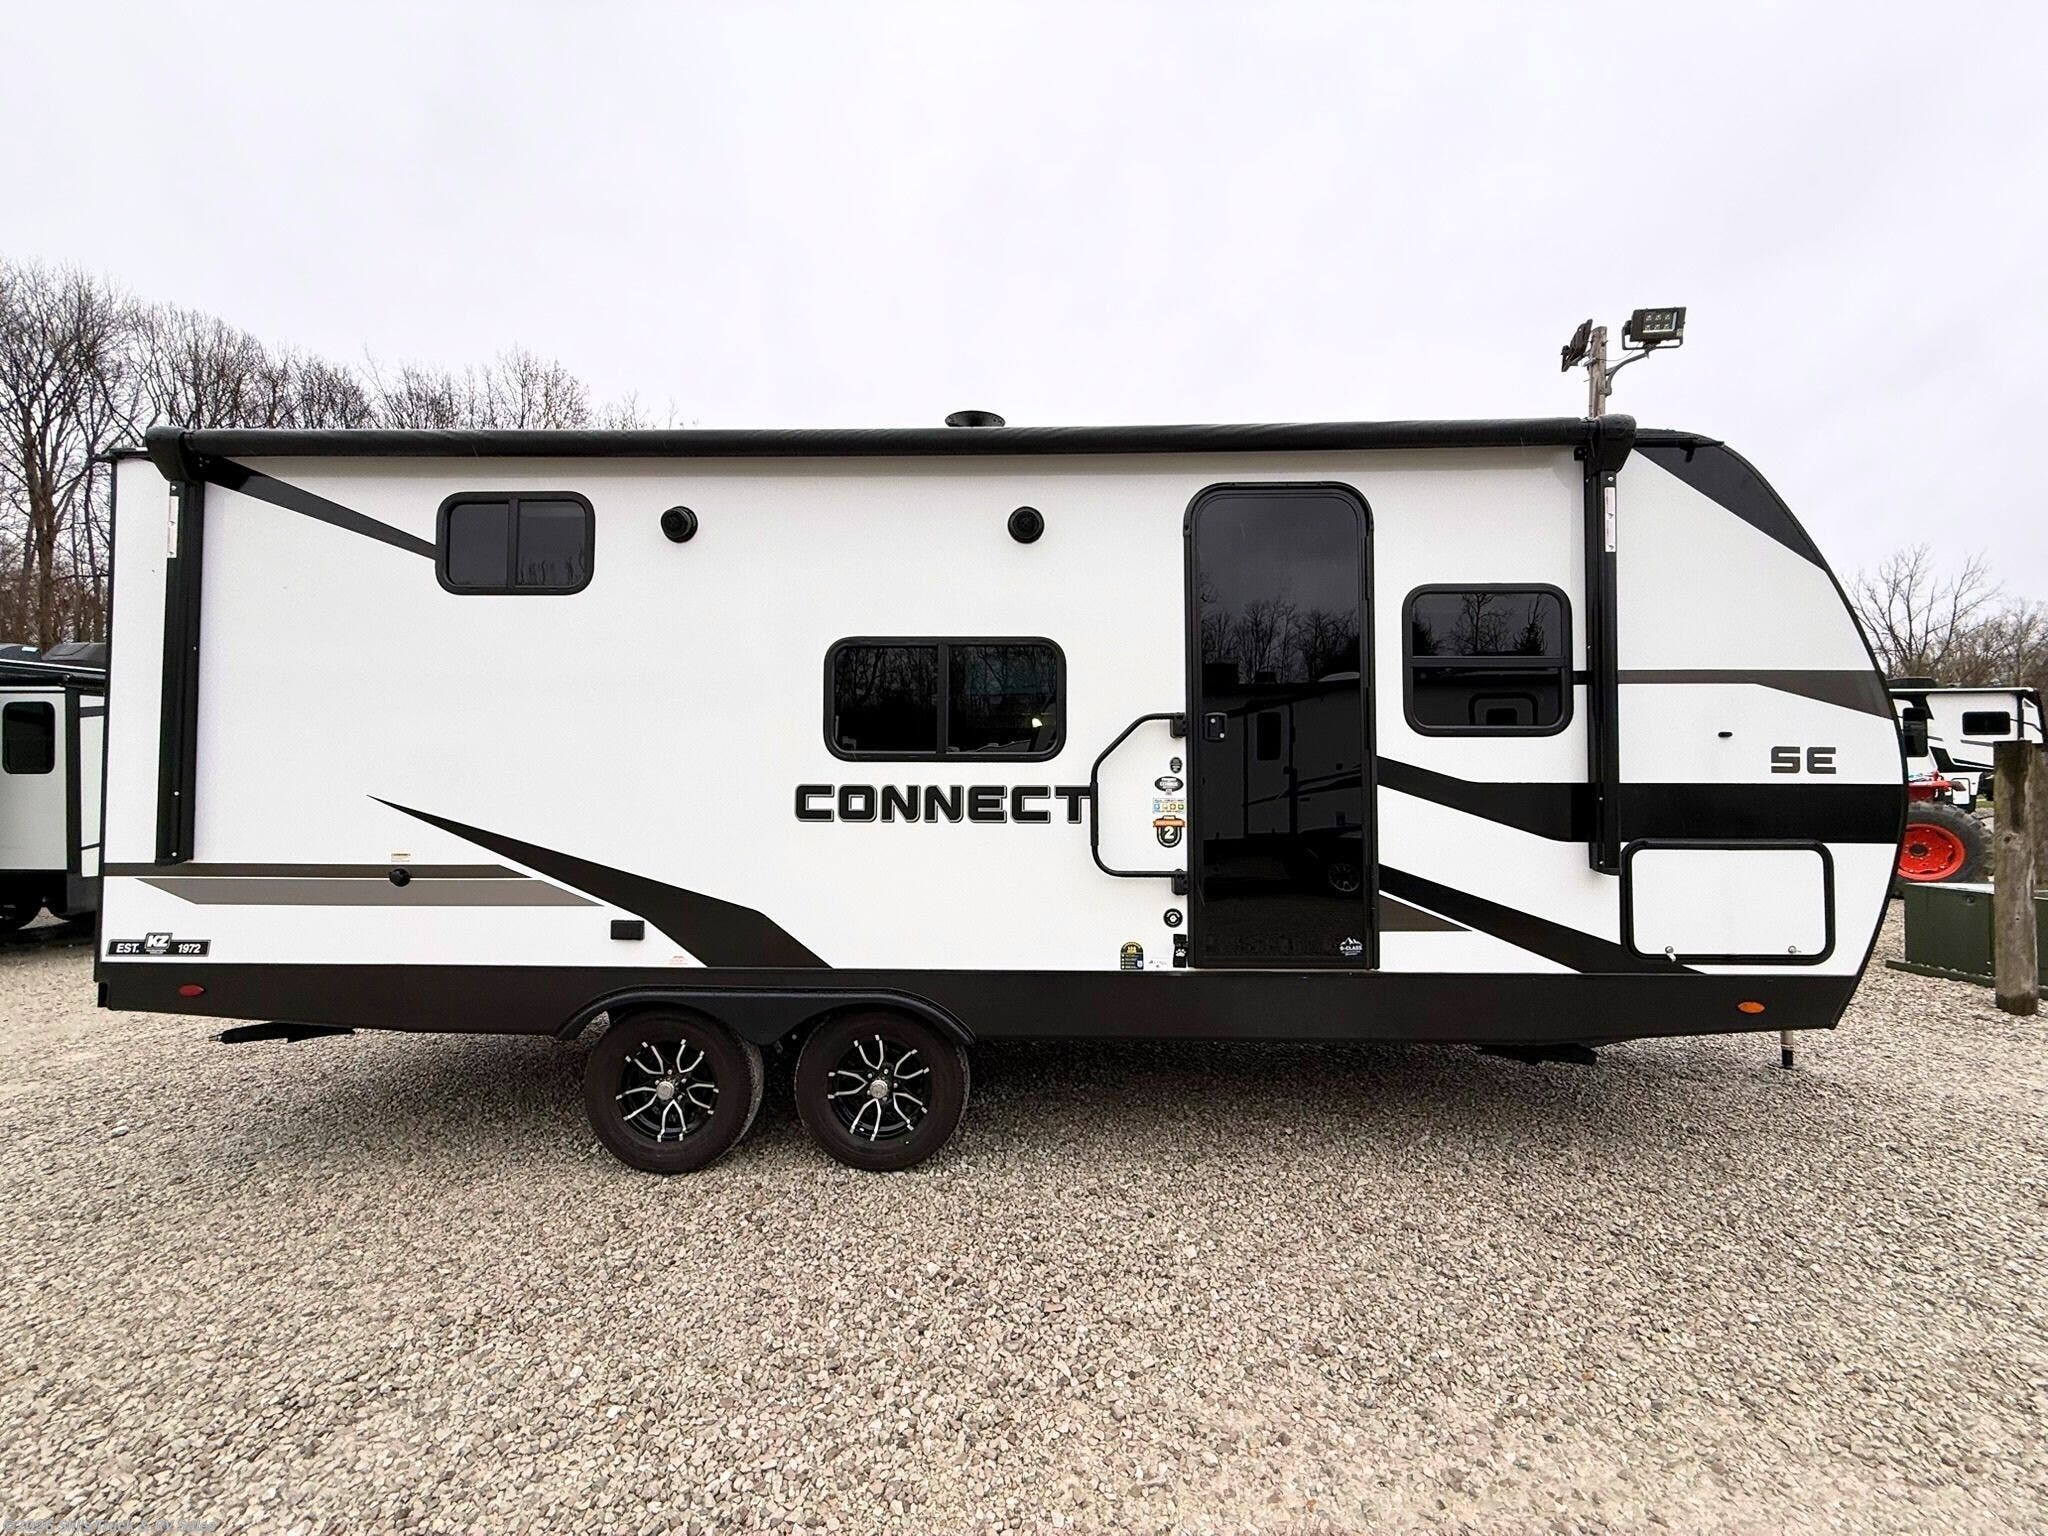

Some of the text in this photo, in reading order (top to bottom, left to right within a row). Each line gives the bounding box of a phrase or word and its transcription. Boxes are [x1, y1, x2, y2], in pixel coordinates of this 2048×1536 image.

[1771, 746, 1837, 774] SE
[795, 784, 1091, 824] CONNECT
[1164, 826, 1175, 840] 2
[116, 943, 139, 953] EST.
[178, 944, 201, 954] 1972
[147, 935, 169, 948] KZ
